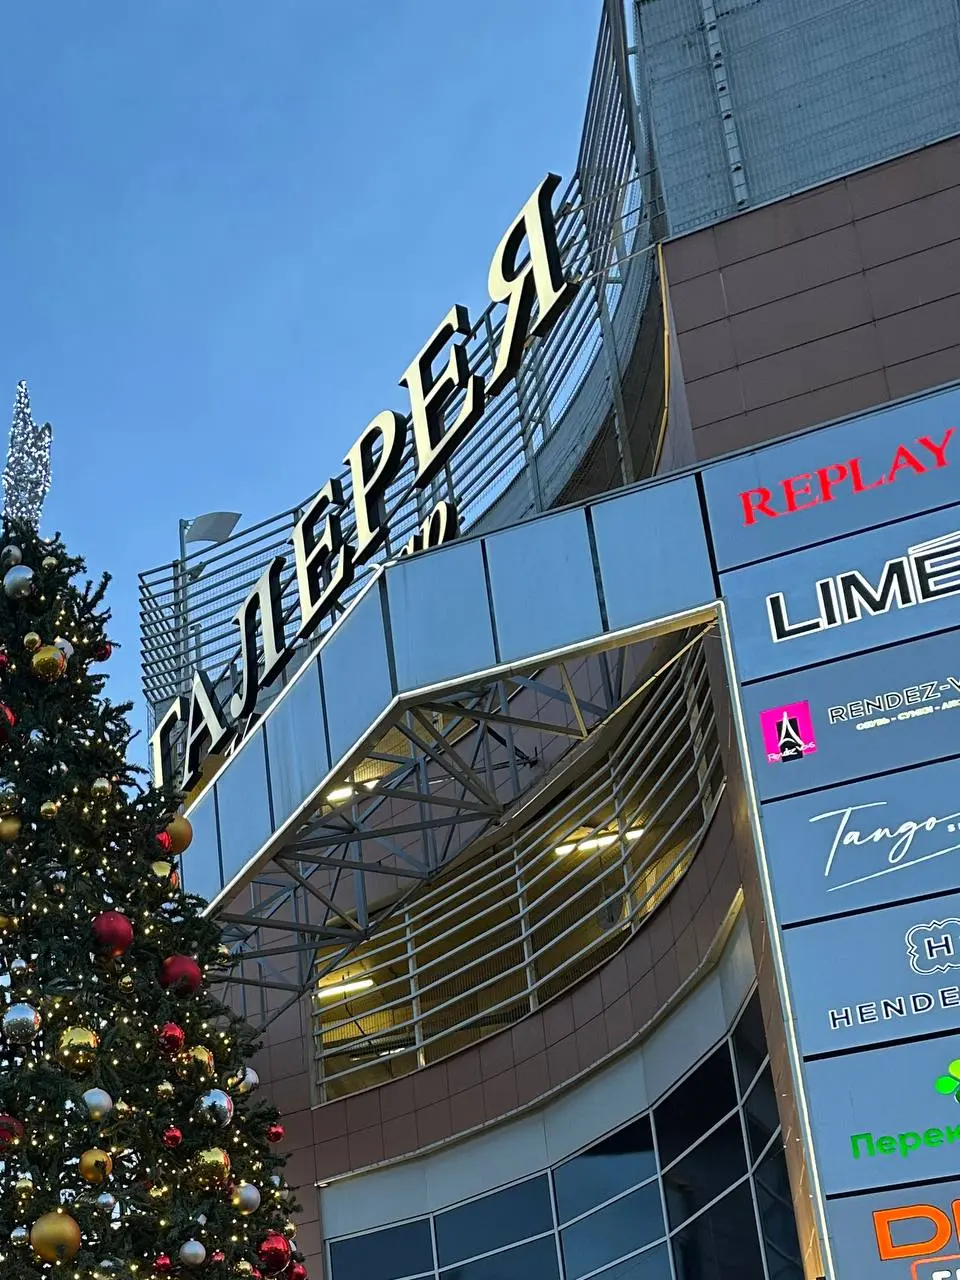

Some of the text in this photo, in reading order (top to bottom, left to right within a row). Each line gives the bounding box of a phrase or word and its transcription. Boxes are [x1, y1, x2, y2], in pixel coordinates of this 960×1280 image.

[151, 172, 575, 791] ГАЛЕРЕЯ
[737, 427, 957, 527] REPLAY
[809, 801, 942, 877] Tango
[828, 986, 960, 1029] HENDE
